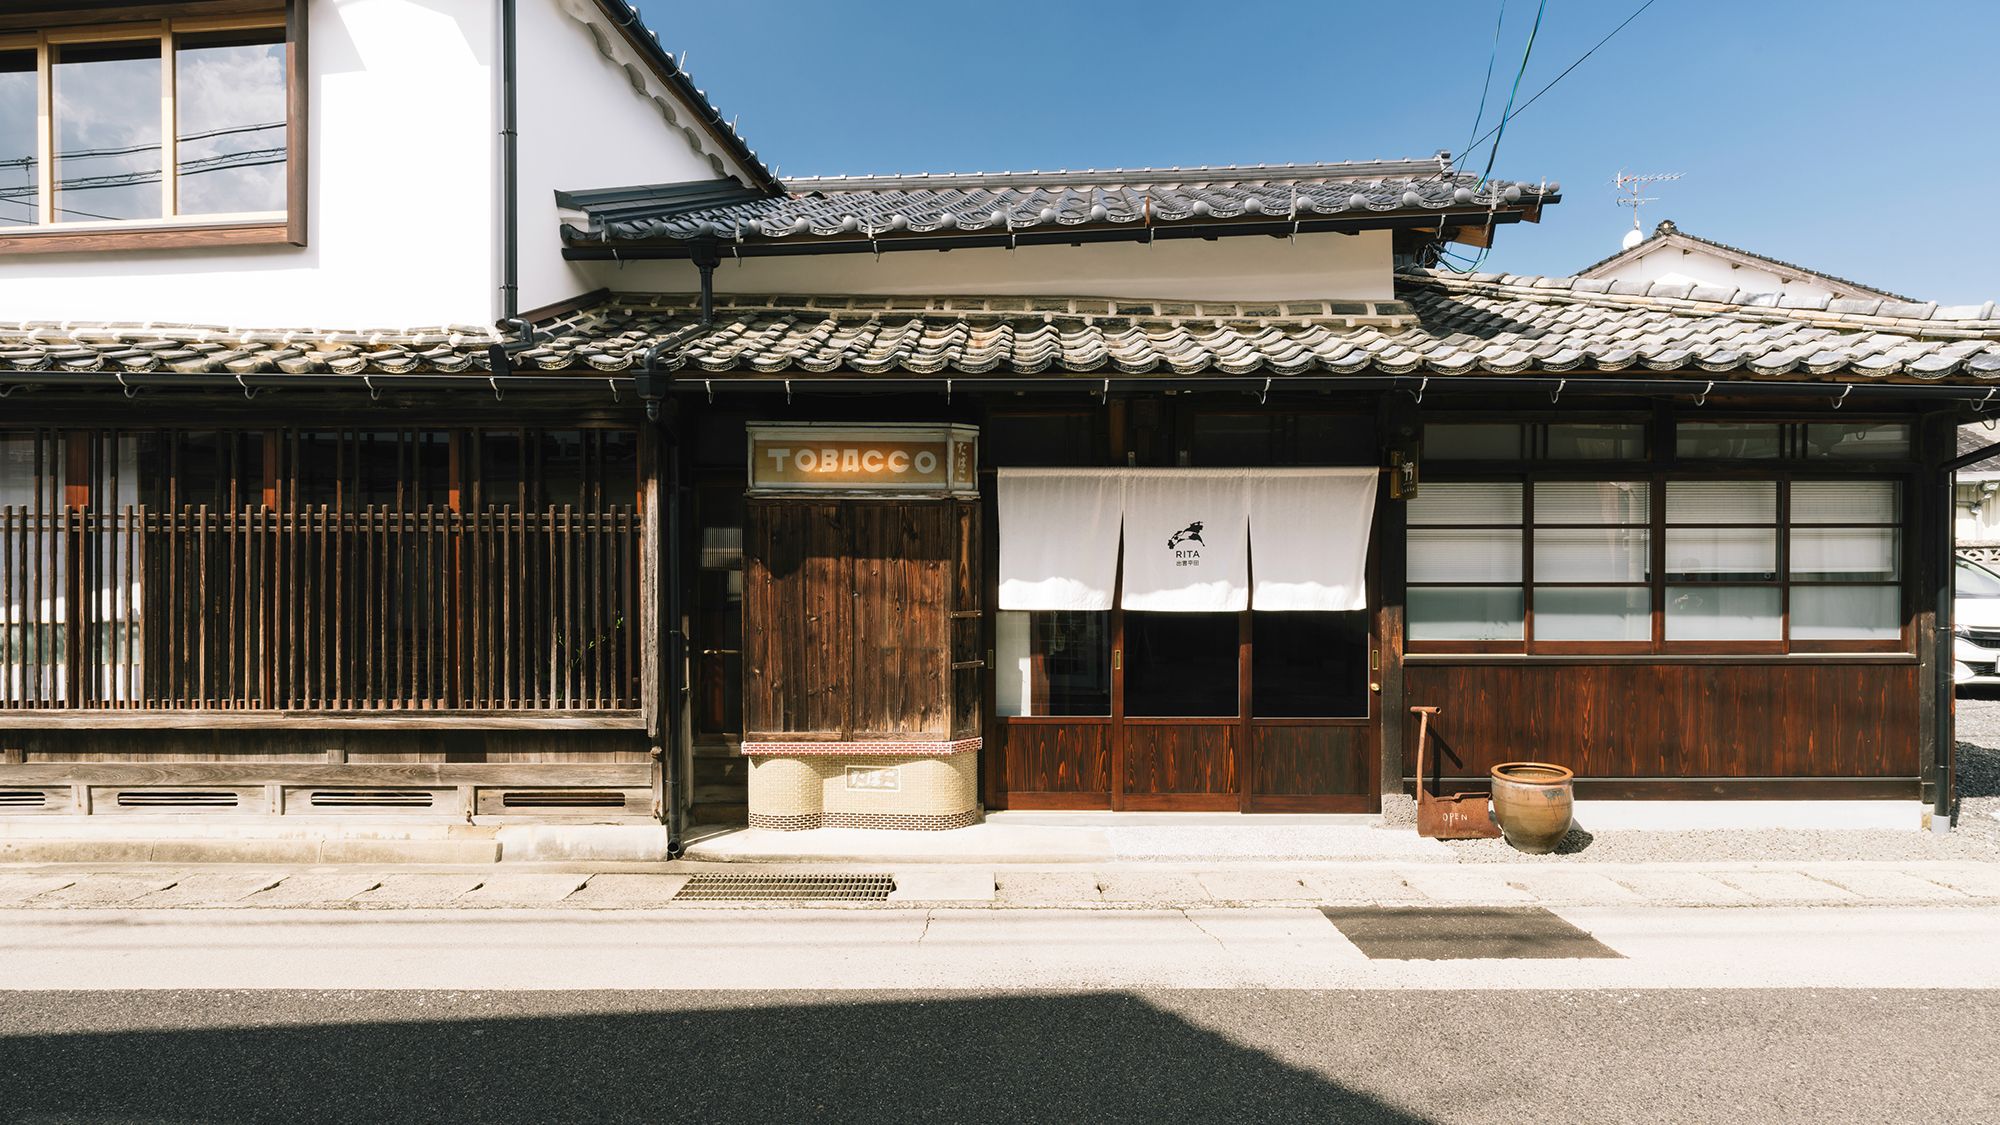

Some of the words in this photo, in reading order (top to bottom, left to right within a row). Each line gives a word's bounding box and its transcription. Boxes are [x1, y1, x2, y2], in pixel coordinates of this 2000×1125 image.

[767, 448, 937, 474] TOBACCO
[1175, 550, 1200, 558] RITA
[1442, 812, 1468, 827] OPEN
